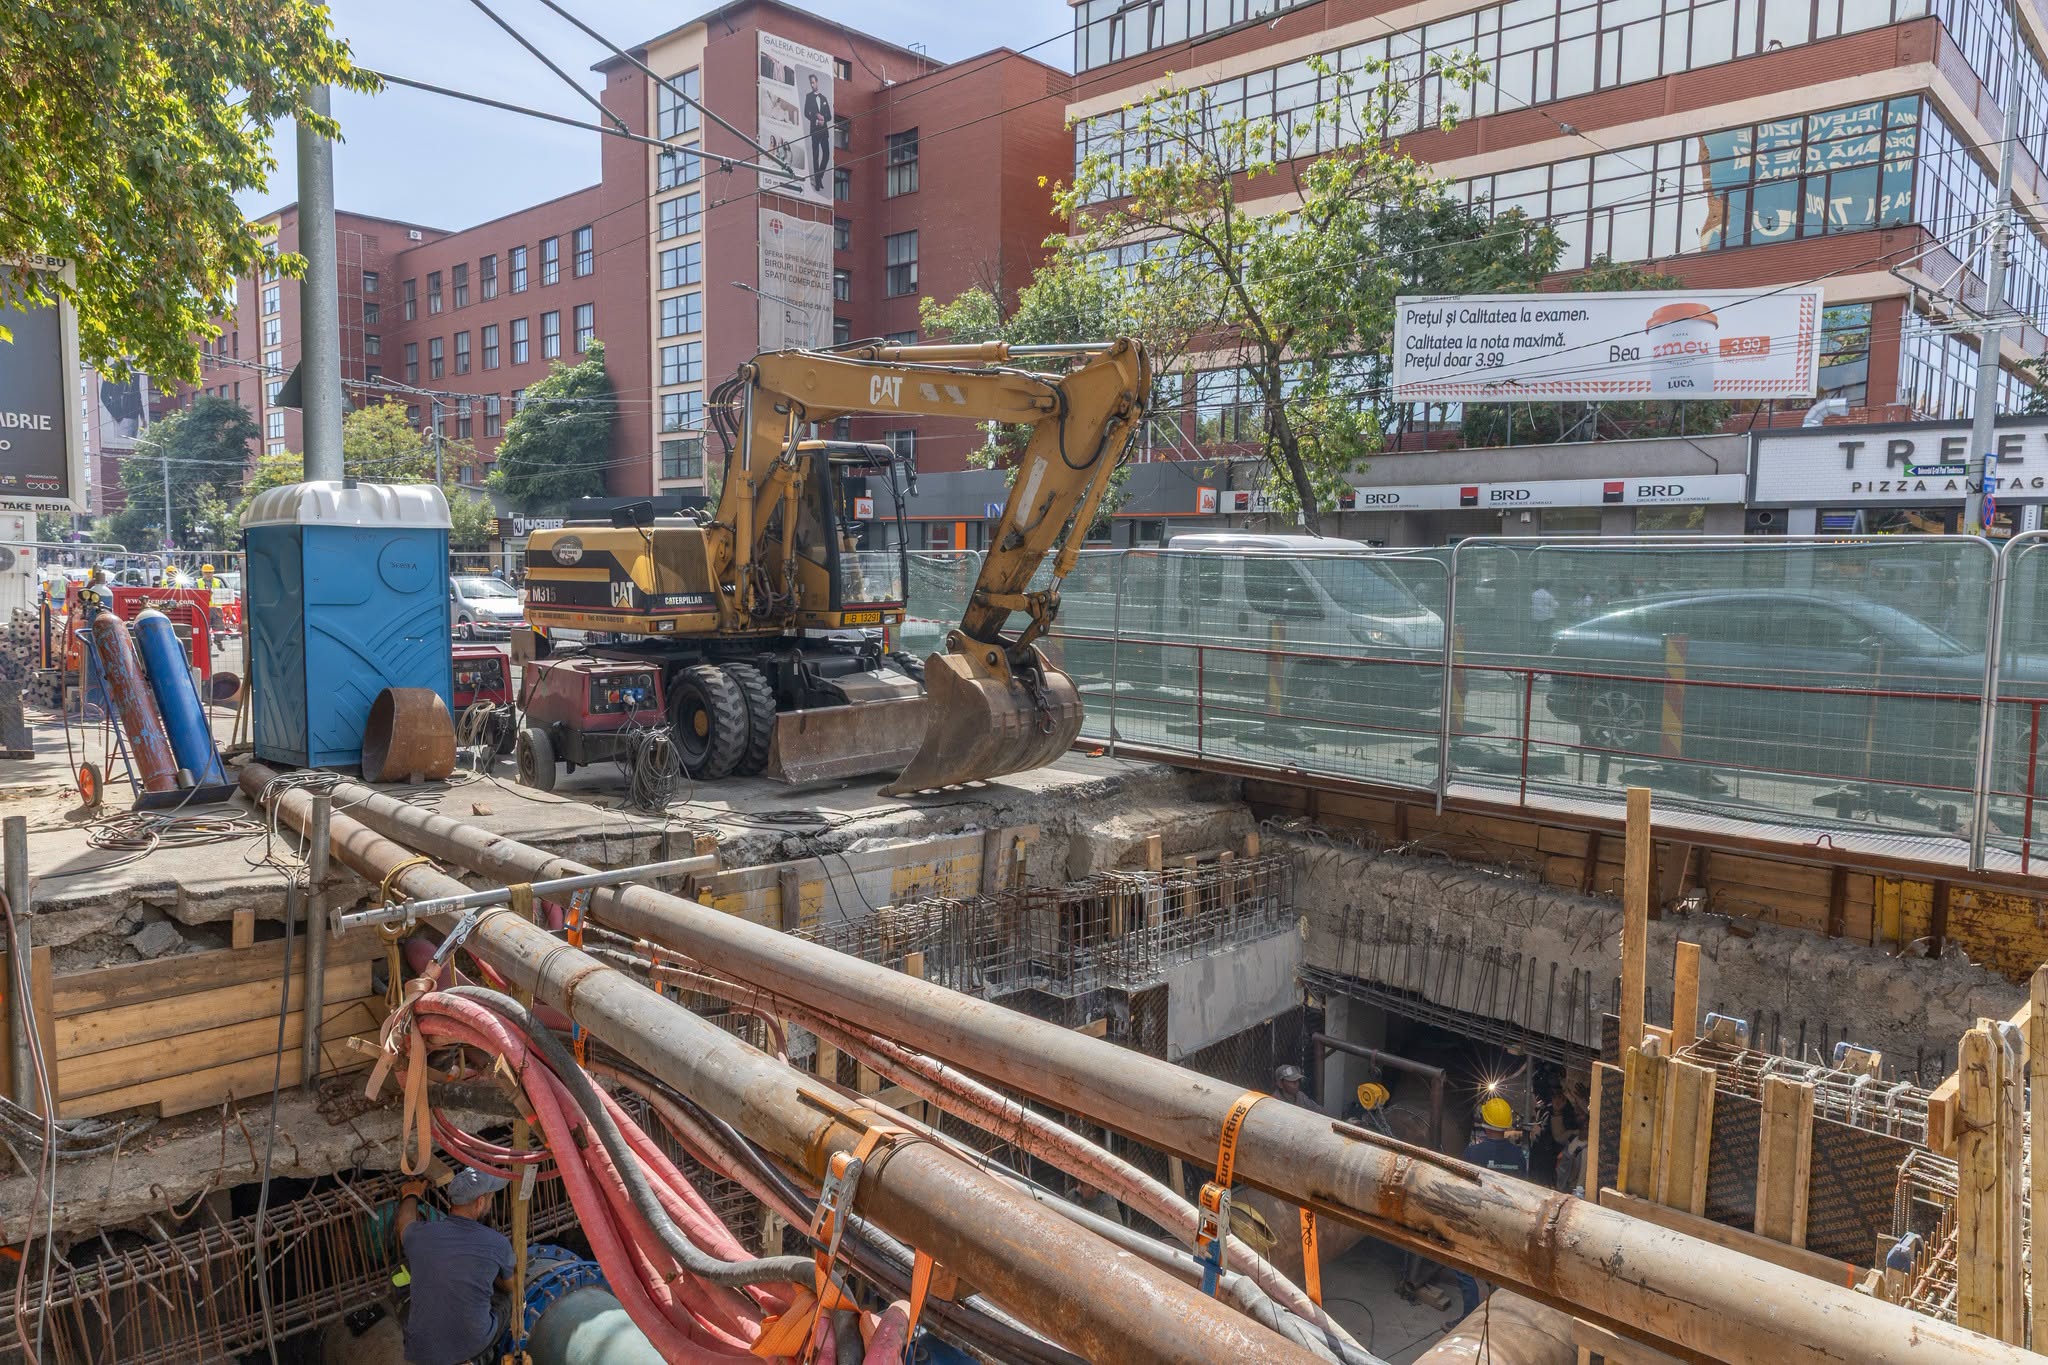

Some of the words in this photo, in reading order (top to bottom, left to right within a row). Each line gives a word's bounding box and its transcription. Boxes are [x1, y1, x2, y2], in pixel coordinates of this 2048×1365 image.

[763, 35, 794, 54] GALERIA
[795, 46, 805, 58] DE
[806, 50, 830, 65] MODA
[764, 258, 794, 272] BIROURI
[798, 265, 830, 280] DEPOZITE
[788, 274, 831, 291] COMERCIALE
[1406, 308, 1443, 328] Prețul
[1445, 309, 1457, 328] și
[1459, 307, 1518, 324] Calitatea
[1520, 307, 1532, 323] la
[1535, 308, 1590, 322] examen.
[1406, 333, 1463, 350] Calitatea
[1465, 334, 1477, 349] la
[1480, 334, 1510, 349] nota
[1512, 332, 1566, 348] maximă.
[1653, 340, 1710, 359] zmeu
[1404, 352, 1441, 371] Prețul
[1443, 352, 1473, 367] doar
[1475, 352, 1504, 367] 3.99
[1609, 345, 1641, 363] Bea
[869, 375, 903, 408] CAT
[1668, 379, 1695, 389] LUCA
[1490, 489, 1531, 501] BRD
[1638, 484, 1685, 498] BRD
[1851, 479, 1927, 493] PIZZA
[2, 502, 32, 511] TAKE
[35, 504, 71, 512] MEDIA
[1365, 493, 1400, 504] BRD
[984, 503, 1006, 519] IN
[610, 581, 634, 609] CAT
[664, 595, 703, 605] CATERPILLAR
[1222, 1104, 1247, 1150] lifting
[1219, 1151, 1231, 1187] Euro
